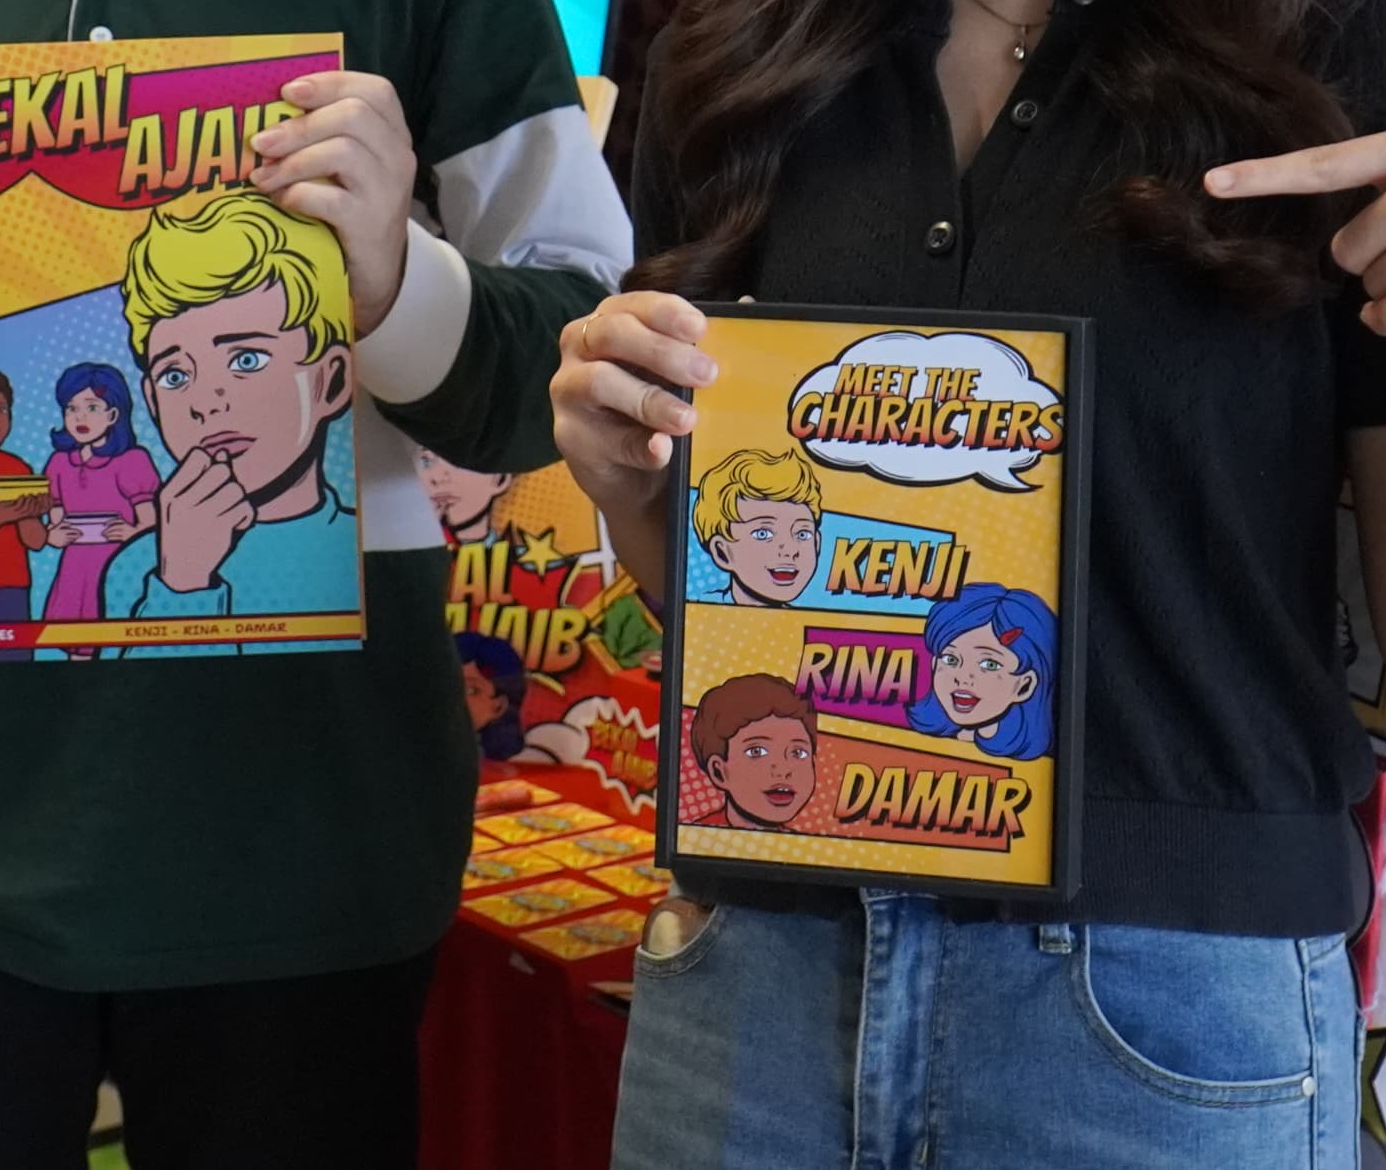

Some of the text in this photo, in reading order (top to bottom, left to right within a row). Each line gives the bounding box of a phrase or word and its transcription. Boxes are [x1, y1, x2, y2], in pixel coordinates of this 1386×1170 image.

[833, 362, 982, 402] MEET THE
[788, 392, 1066, 455] CHARACTERS
[825, 537, 971, 601] KENJI
[125, 623, 168, 637] KENJI
[183, 622, 220, 636] RINA
[235, 621, 288, 635] DAMAR
[795, 642, 919, 707] RINA
[836, 762, 1033, 839] DAMAR
